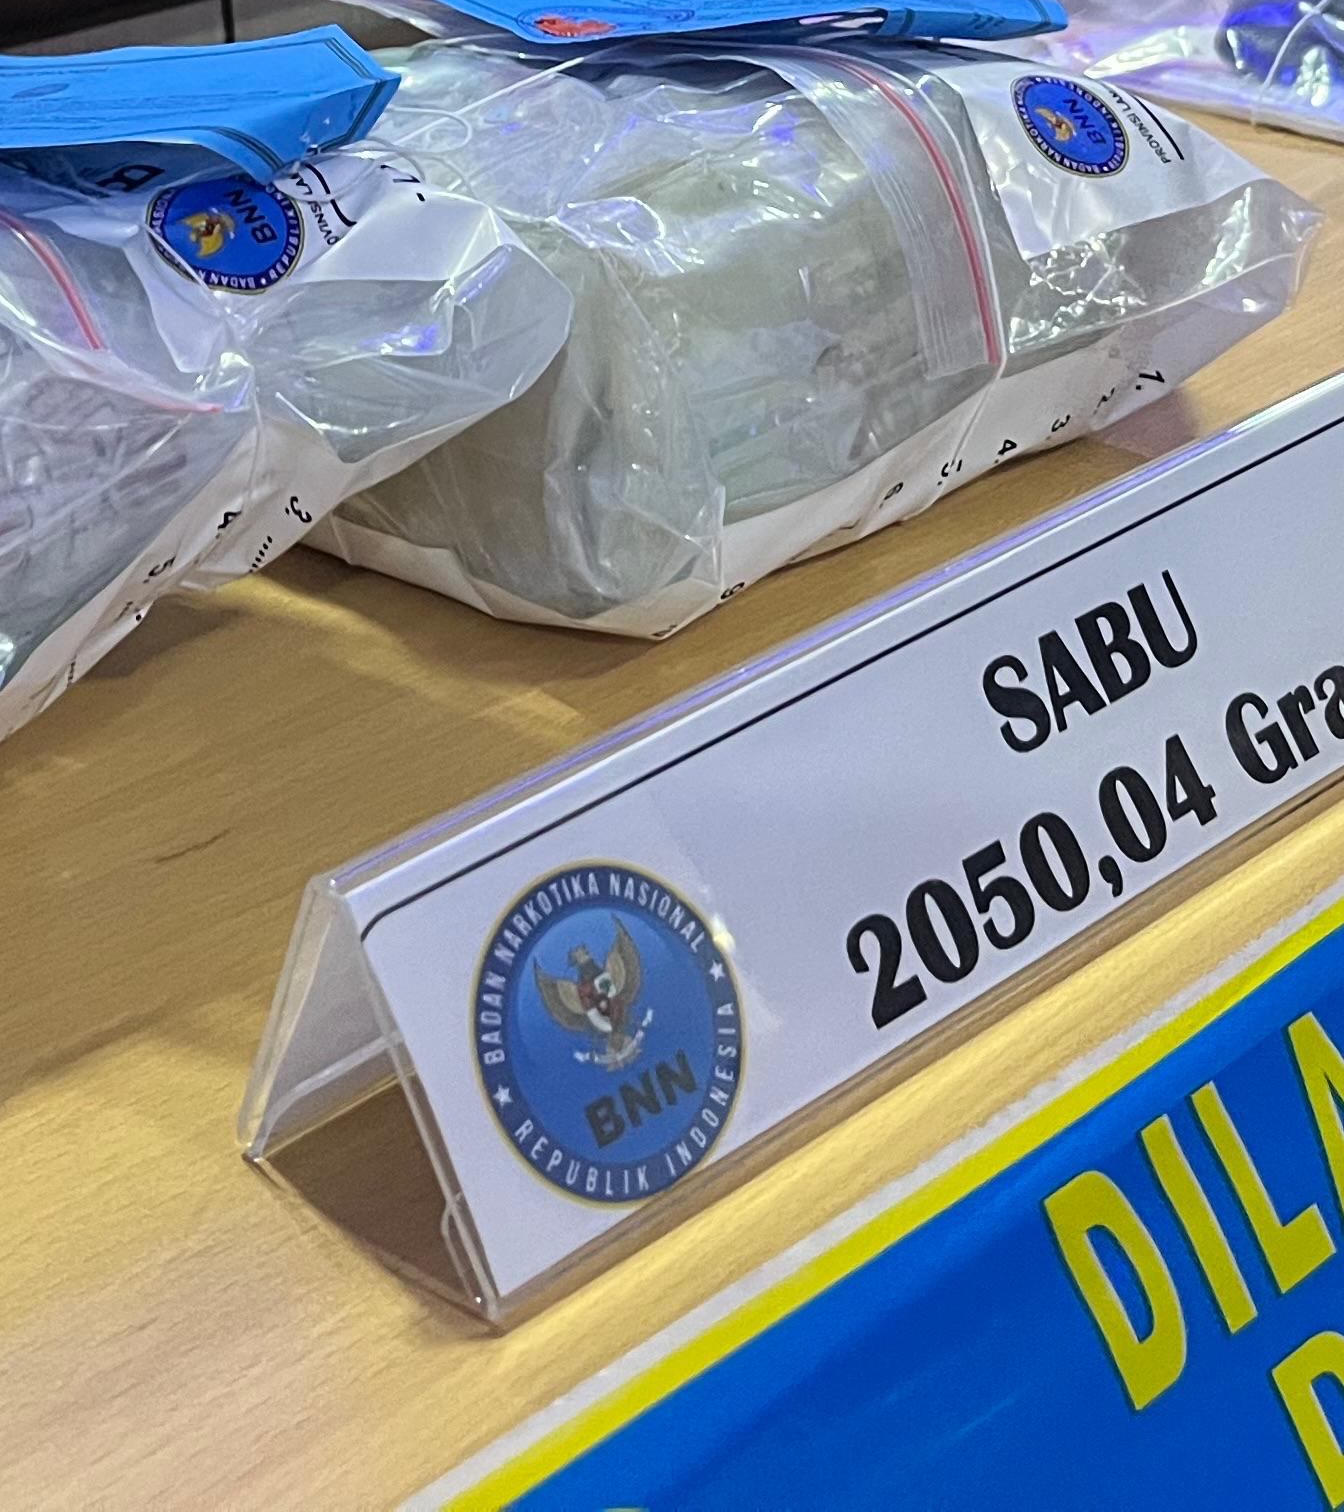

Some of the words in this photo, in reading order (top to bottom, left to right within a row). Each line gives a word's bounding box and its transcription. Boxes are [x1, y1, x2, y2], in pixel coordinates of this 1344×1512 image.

[1063, 98, 1107, 145] BNN
[208, 273, 256, 289] BADAN
[224, 189, 277, 245] BNN
[980, 568, 1201, 755] SABU
[844, 734, 1217, 1030] 2050,04
[480, 970, 507, 1066] BADAN
[494, 871, 600, 967] NARKOTIKA
[609, 871, 708, 954] NASIONAL
[514, 1118, 650, 1196] REPUBLIK
[664, 1001, 738, 1177] INDONESIA
[584, 1047, 698, 1150] BNN
